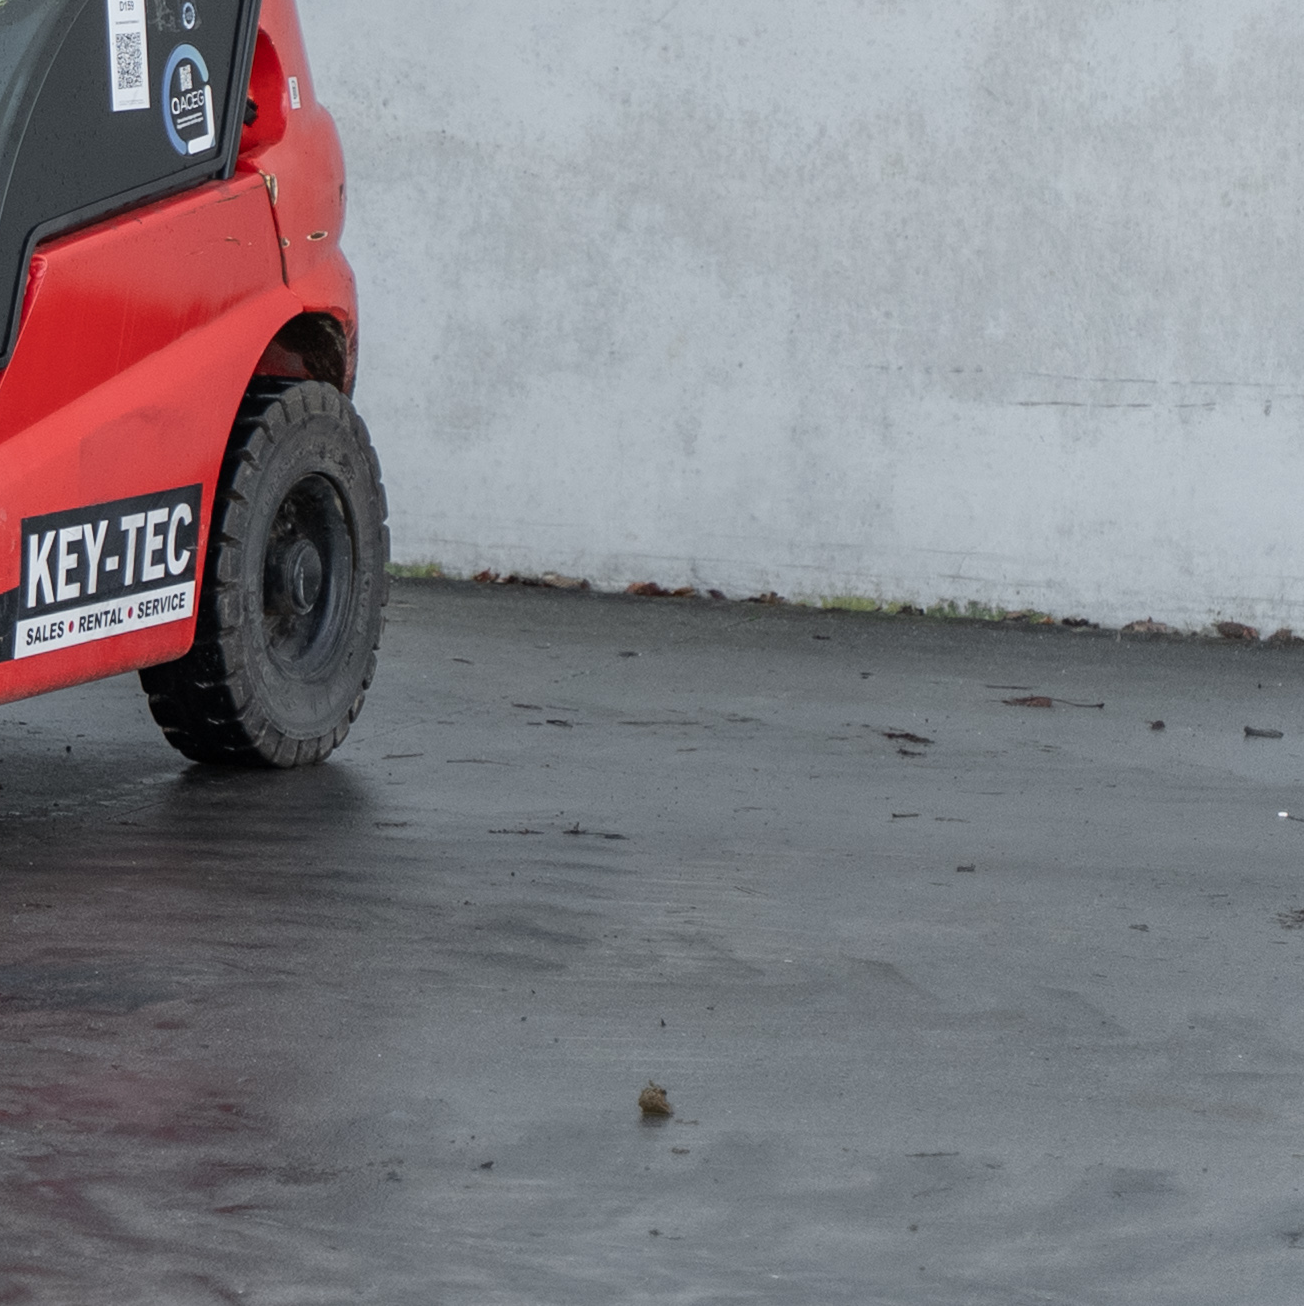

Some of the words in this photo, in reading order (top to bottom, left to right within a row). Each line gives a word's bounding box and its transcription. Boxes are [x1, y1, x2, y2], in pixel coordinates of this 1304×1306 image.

[27, 502, 193, 609] KEY-TEC
[26, 620, 64, 646] SALES
[78, 608, 124, 634] RENTAL
[137, 592, 186, 620] SERVICE
